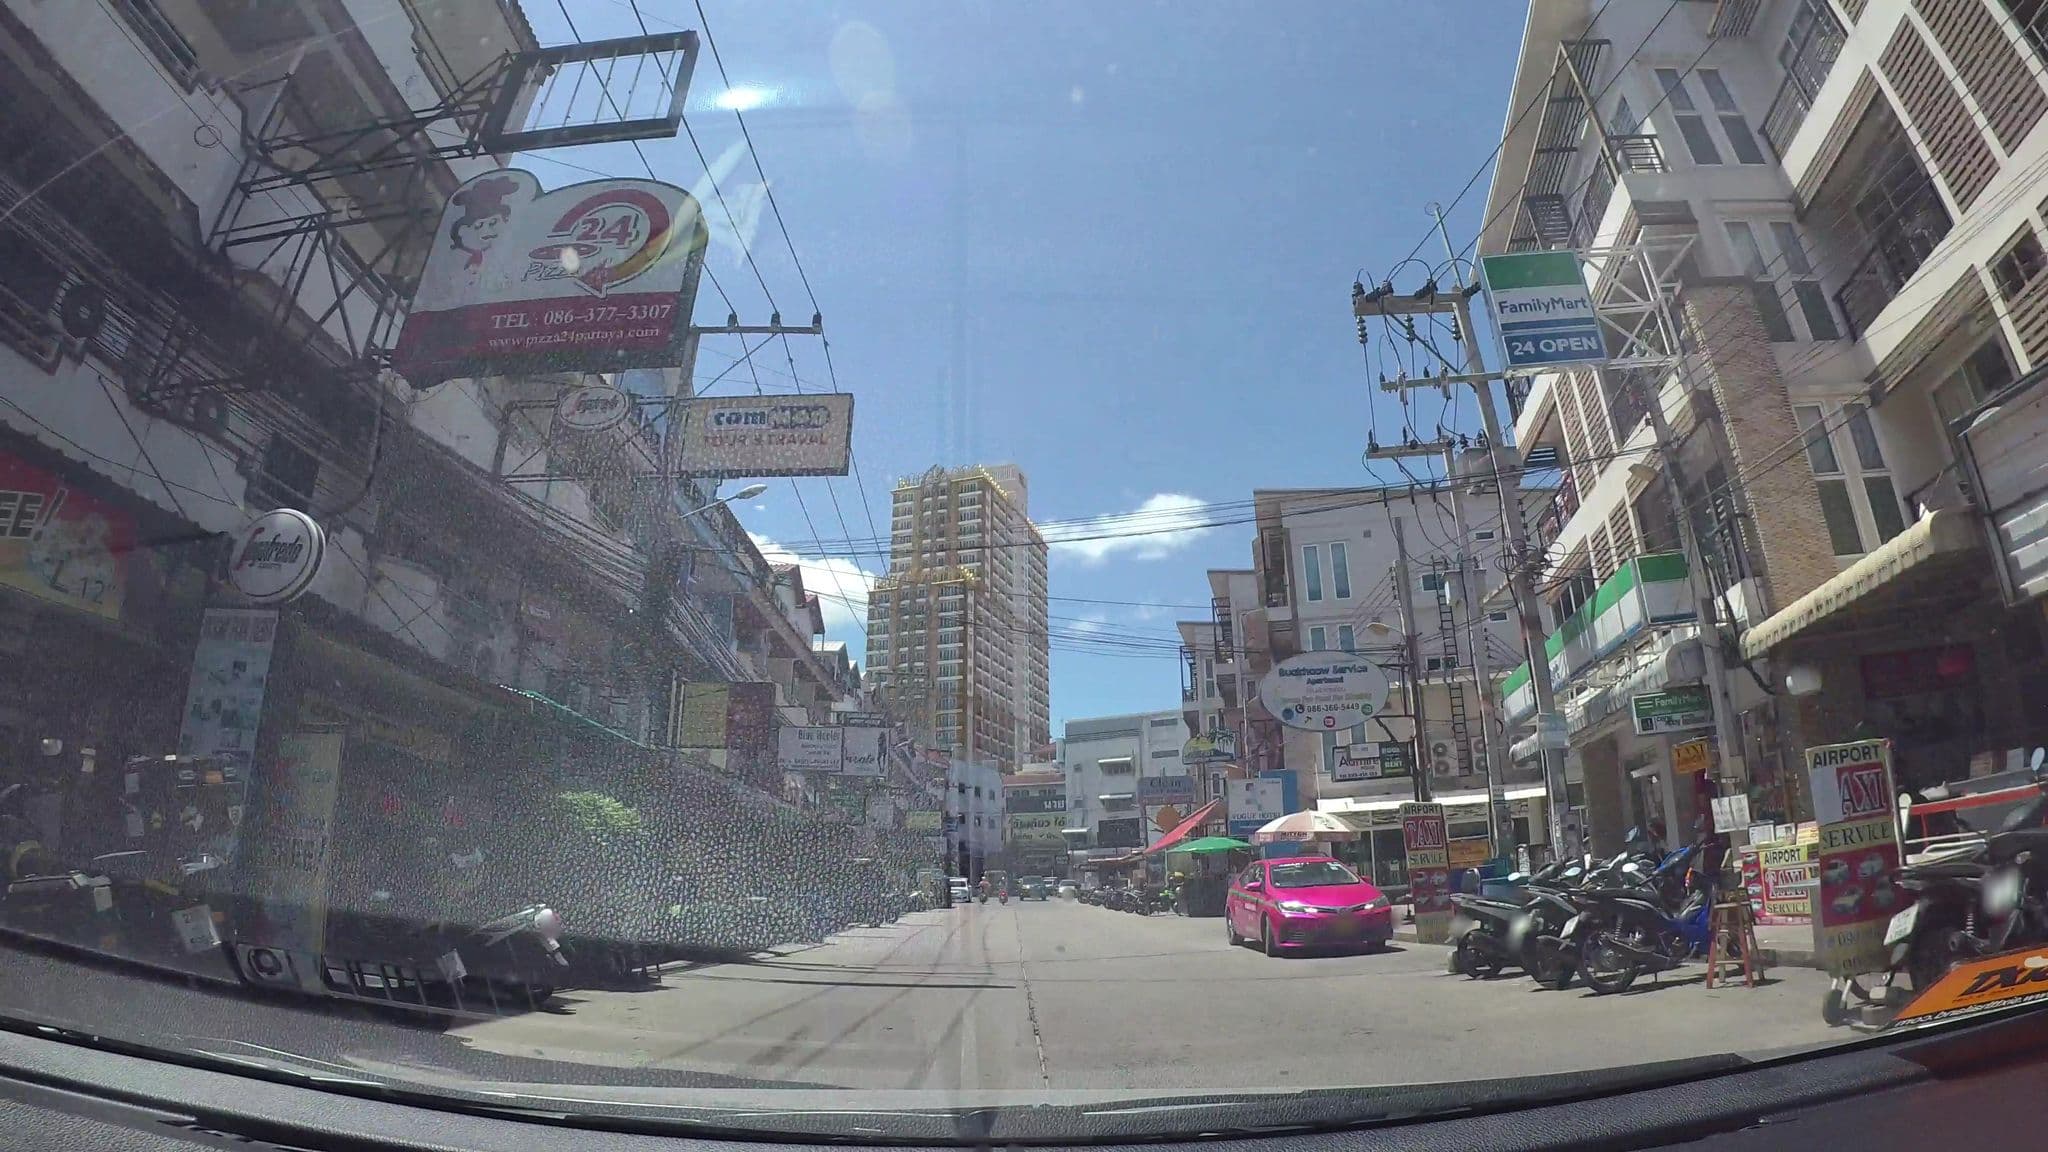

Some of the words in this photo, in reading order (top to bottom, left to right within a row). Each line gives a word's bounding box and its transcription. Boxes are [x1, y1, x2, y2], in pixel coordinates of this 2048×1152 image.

[575, 215, 635, 246] 24
[492, 313, 529, 328] TEL
[544, 304, 672, 325] 086-377-3307
[1499, 296, 1588, 316] FamilyMart
[1512, 341, 1535, 356] 24
[1539, 336, 1598, 352] OPEN
[1812, 744, 1881, 768] AIRPORT
[1840, 770, 1887, 816] AXI
[1405, 803, 1439, 815] AIRPORT
[1405, 820, 1443, 848] TAXI
[1764, 848, 1801, 865] AIRPORT
[1766, 902, 1808, 914] SERVICE
